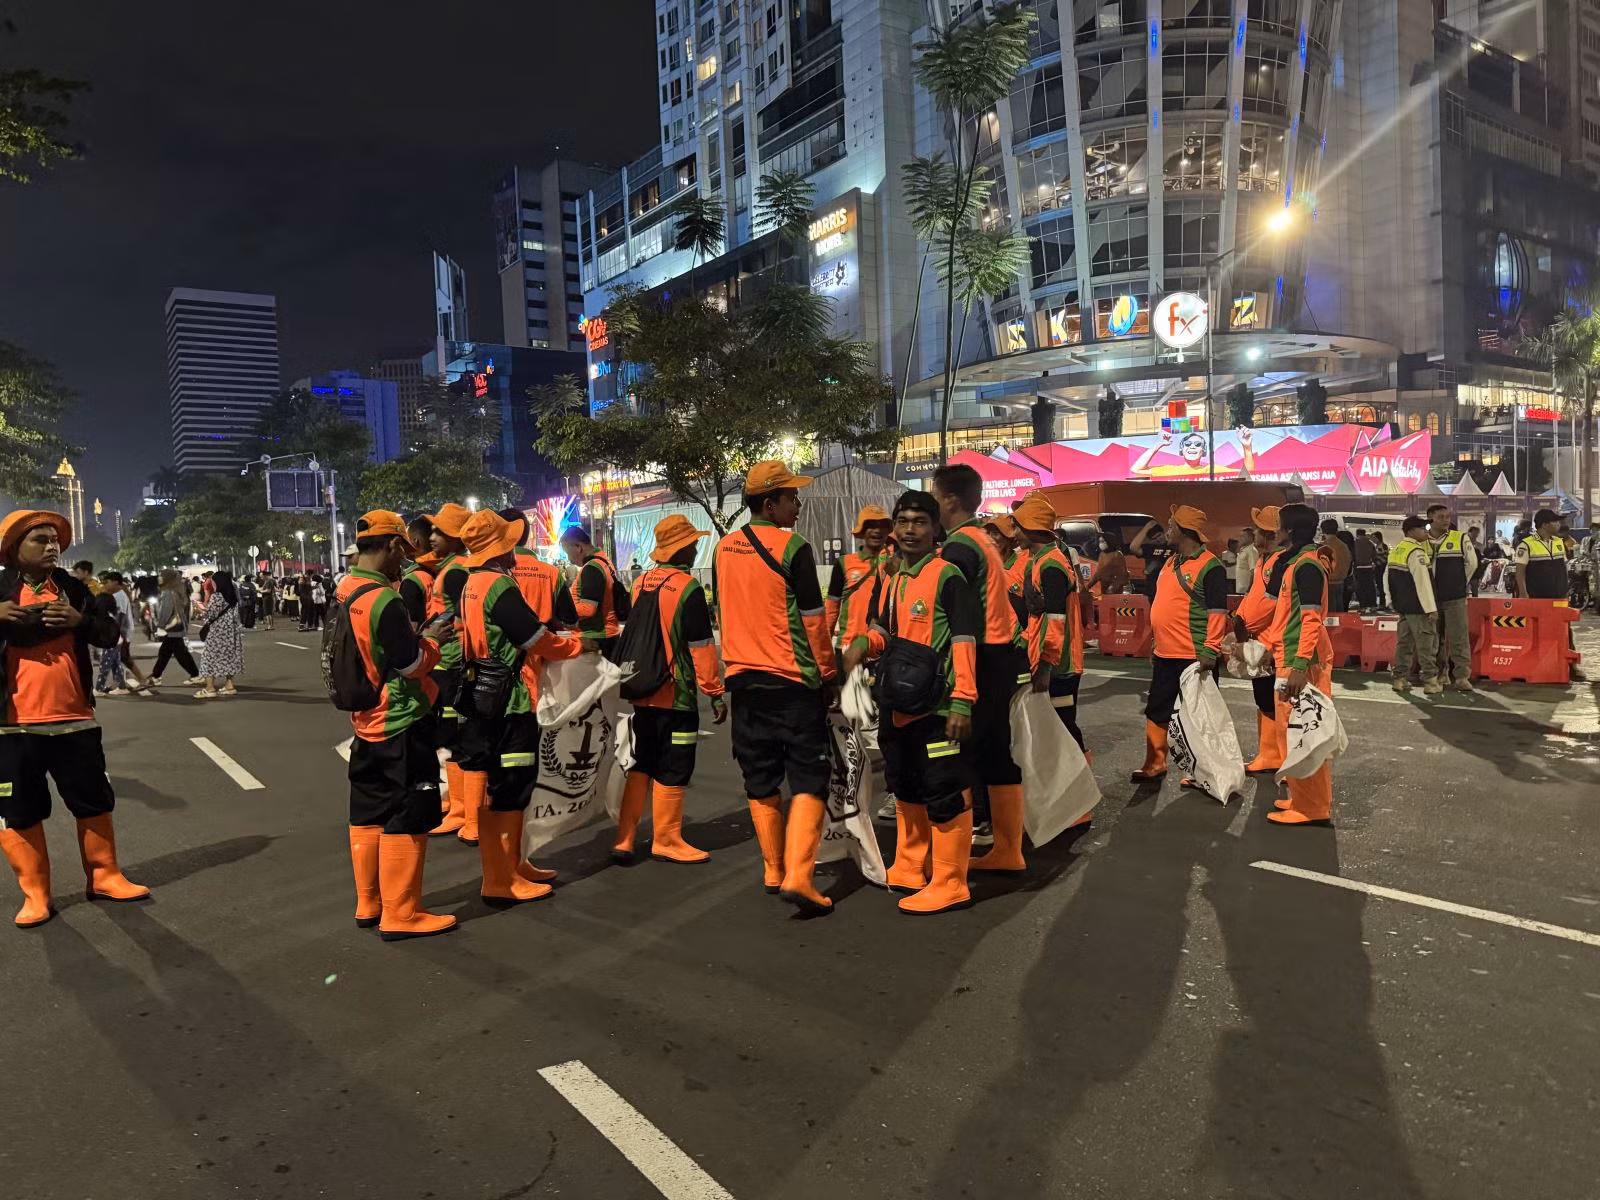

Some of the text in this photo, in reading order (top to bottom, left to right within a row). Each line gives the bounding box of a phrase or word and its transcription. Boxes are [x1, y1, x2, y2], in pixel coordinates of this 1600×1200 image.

[808, 207, 848, 241] HARRIS
[1360, 456, 1389, 478] AIA
[1001, 488, 1017, 498] LIVES
[1493, 656, 1513, 666] K537
